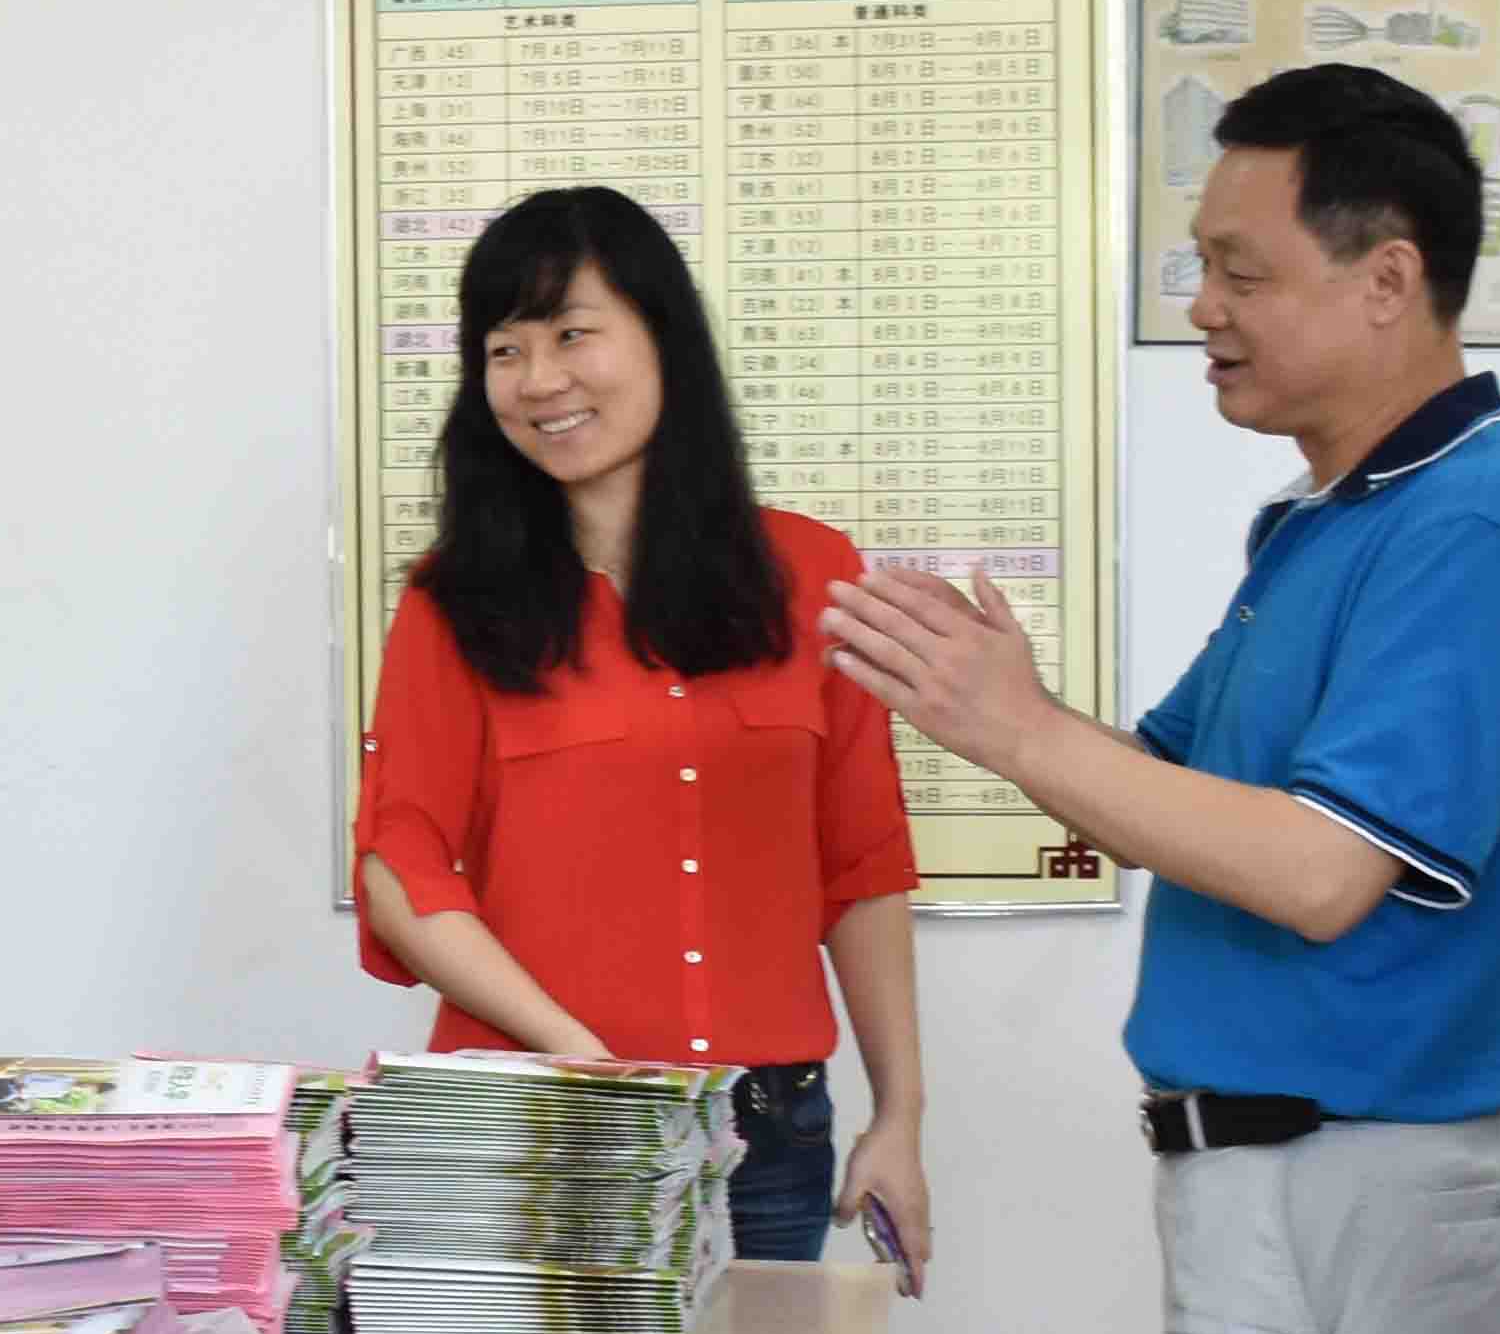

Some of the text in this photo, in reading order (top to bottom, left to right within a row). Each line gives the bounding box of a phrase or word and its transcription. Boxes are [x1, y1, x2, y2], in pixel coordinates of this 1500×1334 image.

[855, 3, 928, 20] 普通科类
[504, 13, 577, 30] 艺术科类
